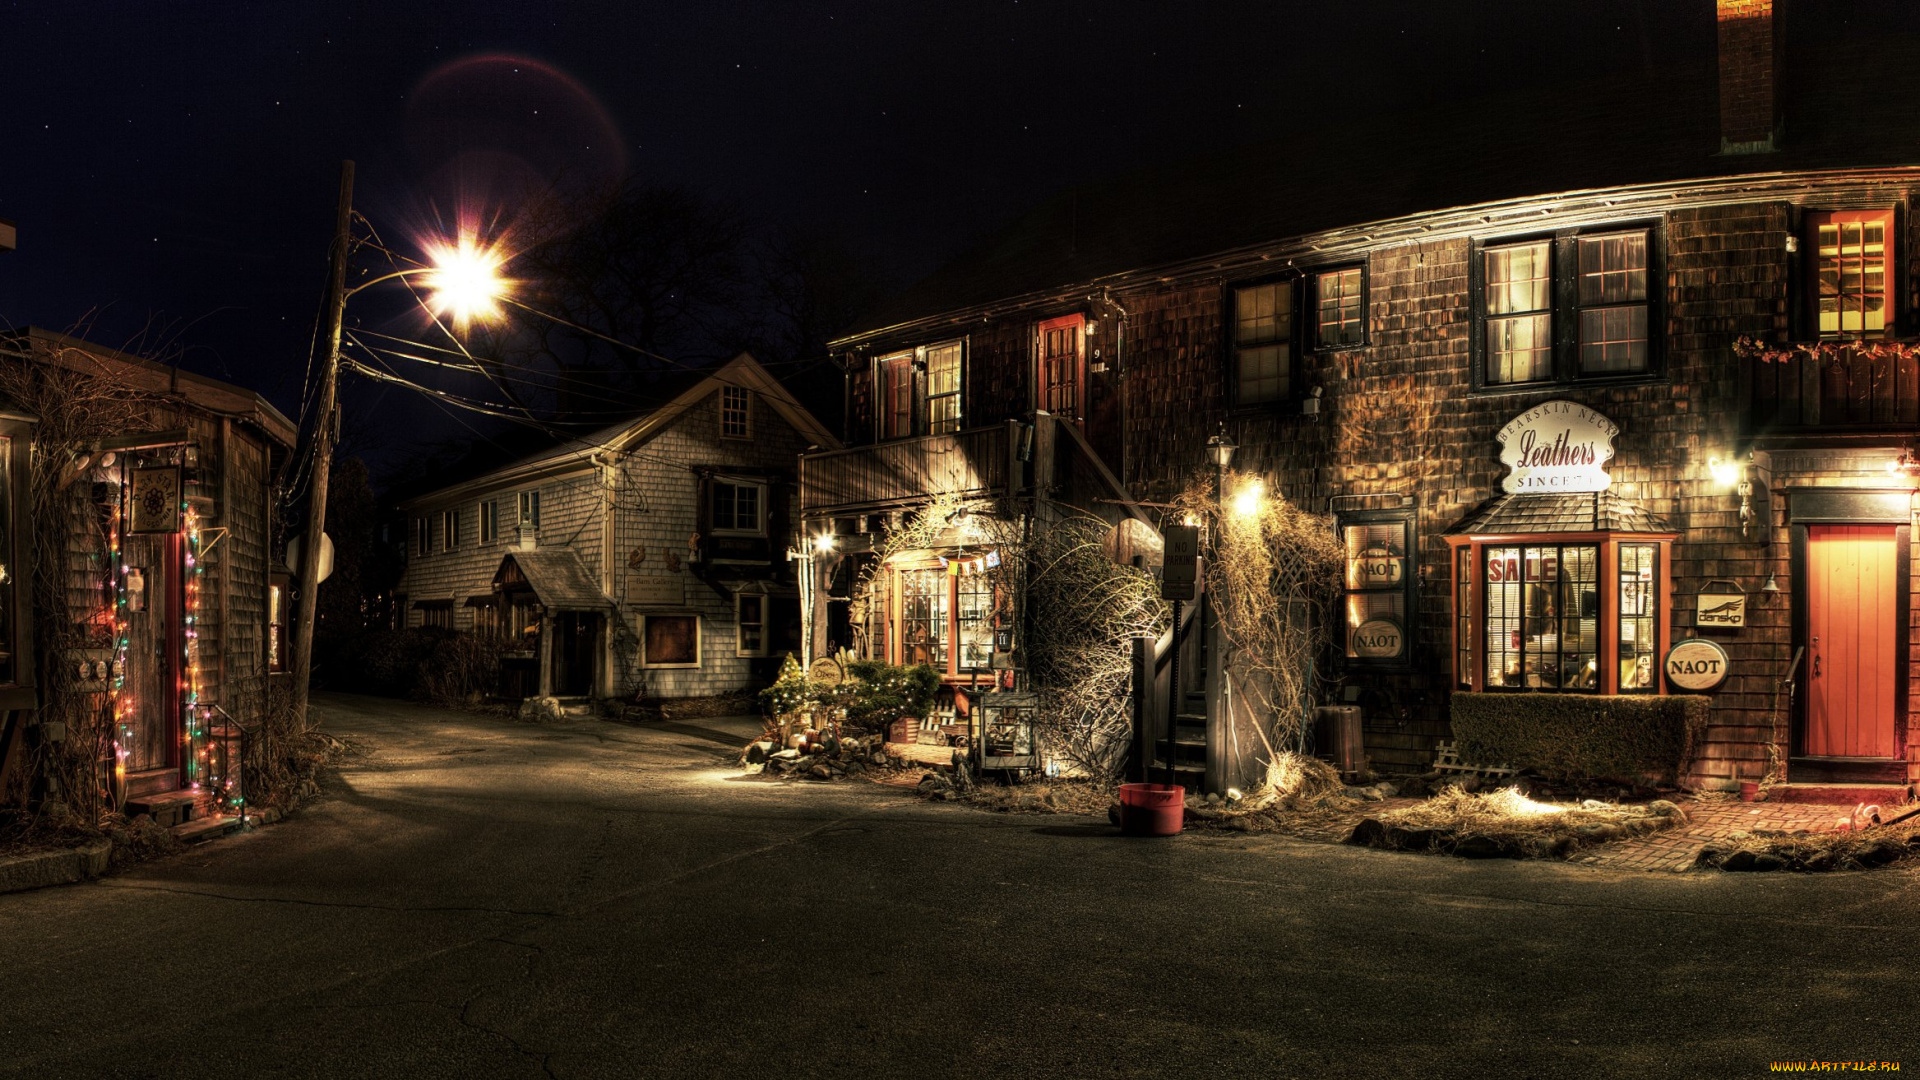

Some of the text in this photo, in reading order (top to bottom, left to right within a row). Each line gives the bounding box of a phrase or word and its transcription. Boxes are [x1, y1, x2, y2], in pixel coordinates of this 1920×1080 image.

[1094, 349, 1100, 358] 9
[1500, 403, 1615, 441] BEARSKIN NECK
[1517, 428, 1595, 468] Leathers
[1517, 476, 1570, 487] SINCE
[1174, 541, 1188, 553] NO
[1166, 555, 1195, 566] PARKING
[1358, 563, 1397, 576] NAOT
[1488, 558, 1556, 581] SALE
[1699, 610, 1741, 624] dansko
[1357, 635, 1398, 648] NAOT
[1671, 660, 1720, 674] NAOT
